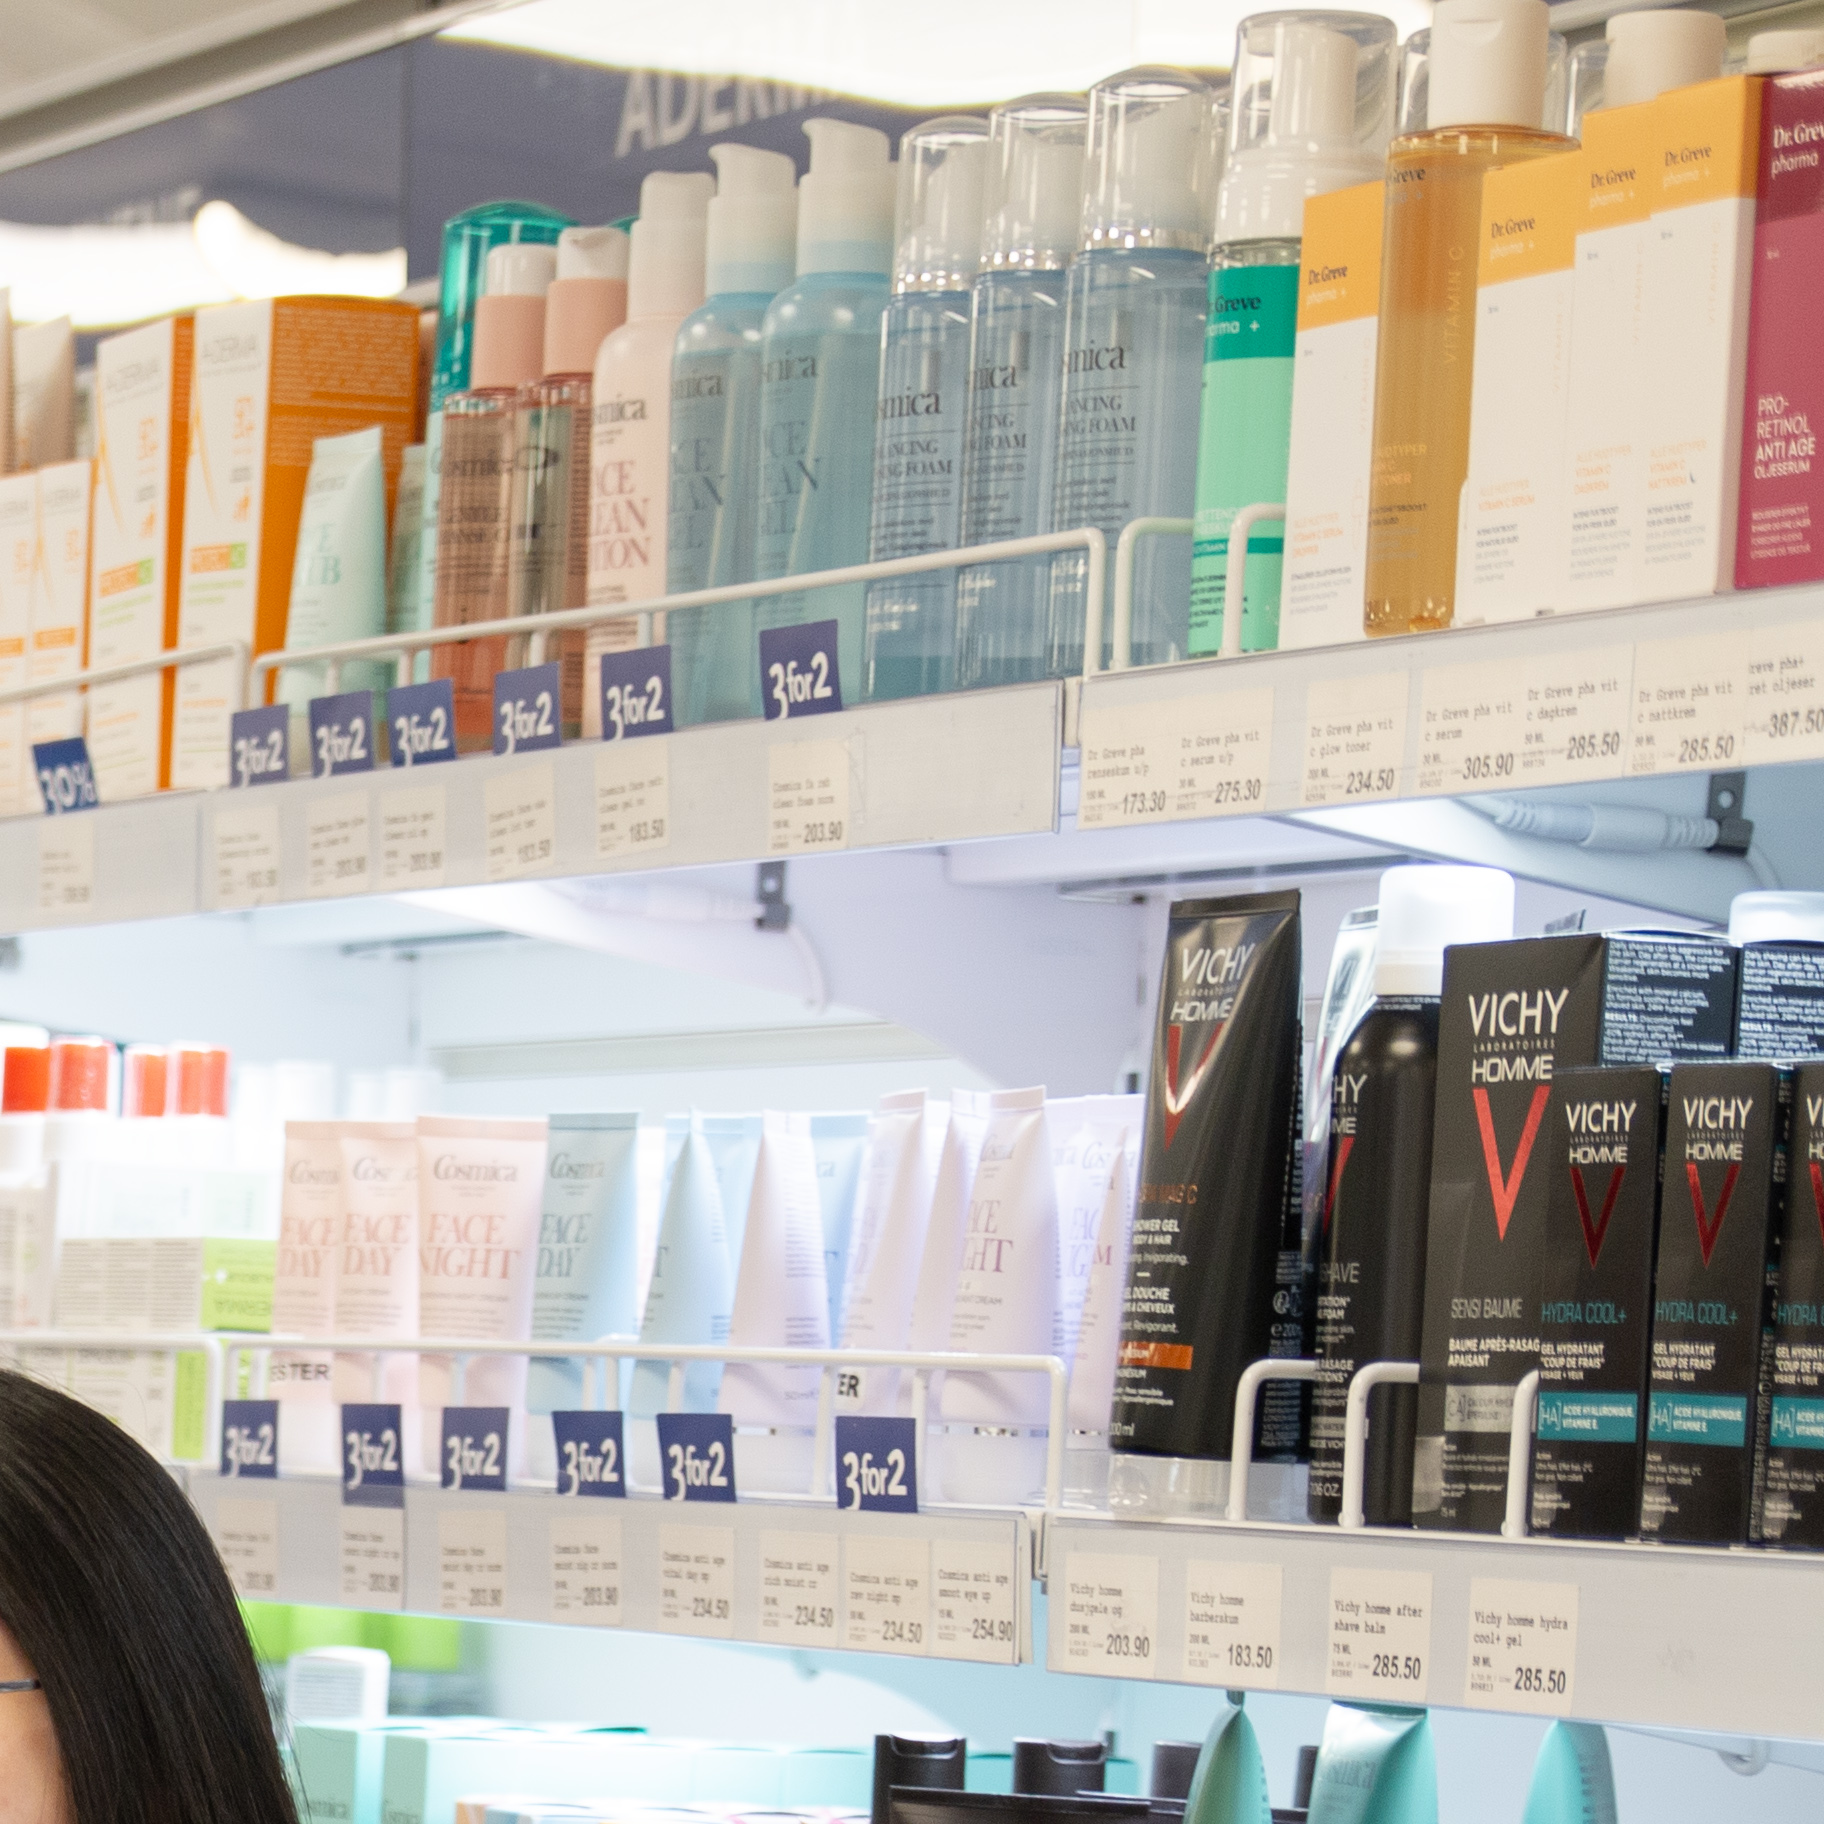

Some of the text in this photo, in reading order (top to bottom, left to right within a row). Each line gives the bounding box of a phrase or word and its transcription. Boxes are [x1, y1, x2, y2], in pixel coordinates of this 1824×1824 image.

[616, 69, 850, 156] ADER
[1771, 150, 1819, 180] pharma
[1758, 396, 1789, 416] PRO-
[1756, 414, 1811, 440] RETINOL
[1755, 436, 1816, 463] ANTI AGE
[1754, 459, 1811, 480] OLJESERUM
[1768, 709, 1824, 739] 387.50
[1567, 732, 1620, 760] 285.50
[1678, 734, 1734, 763] 285.50
[1463, 753, 1513, 780] 305.90
[1215, 779, 1261, 804] 275.30
[1346, 769, 1394, 795] 234.50
[1122, 790, 1166, 814] 173.30
[1182, 943, 1255, 985] VICHY
[1169, 997, 1234, 1022] HOMME
[1469, 988, 1569, 1037] VICHY
[1472, 1054, 1554, 1084] HOMME
[1565, 1101, 1637, 1134] VICHY
[1683, 1095, 1753, 1130] VICHY
[1569, 1145, 1628, 1165] HOMME
[1685, 1142, 1743, 1162] HOMME
[433, 1152, 519, 1184] Cosmica
[427, 1212, 507, 1244] FACE
[342, 1246, 401, 1278] DAY
[419, 1248, 522, 1280] NIGHT
[1451, 1298, 1523, 1320] SENSI BAUME
[1541, 1302, 1627, 1325] HYDRA COOL+
[1655, 1301, 1738, 1326] HYDRA COOL+
[1777, 1302, 1817, 1326] HYDRA
[1449, 1336, 1540, 1354] BAUME APRÈS-RASAG
[1557, 1342, 1604, 1358] HYDRATANT
[1669, 1343, 1716, 1359] HYDRATANT
[270, 1363, 331, 1382] ESTER
[1448, 1354, 1490, 1368] APAISANT
[795, 1605, 833, 1628] 234.50
[1335, 1600, 1422, 1618] Vichy homme after
[1474, 1611, 1568, 1632] Vichy homme hydra
[882, 1620, 922, 1644] 234.50
[972, 1618, 1013, 1643] 254.90
[1334, 1621, 1386, 1635] shave balm
[1473, 1632, 1523, 1649] cool+ gel
[1106, 1634, 1150, 1658] 203.90
[1227, 1643, 1272, 1669] 183.50
[1372, 1653, 1421, 1680] 285.50
[1514, 1667, 1566, 1695] 285.50
